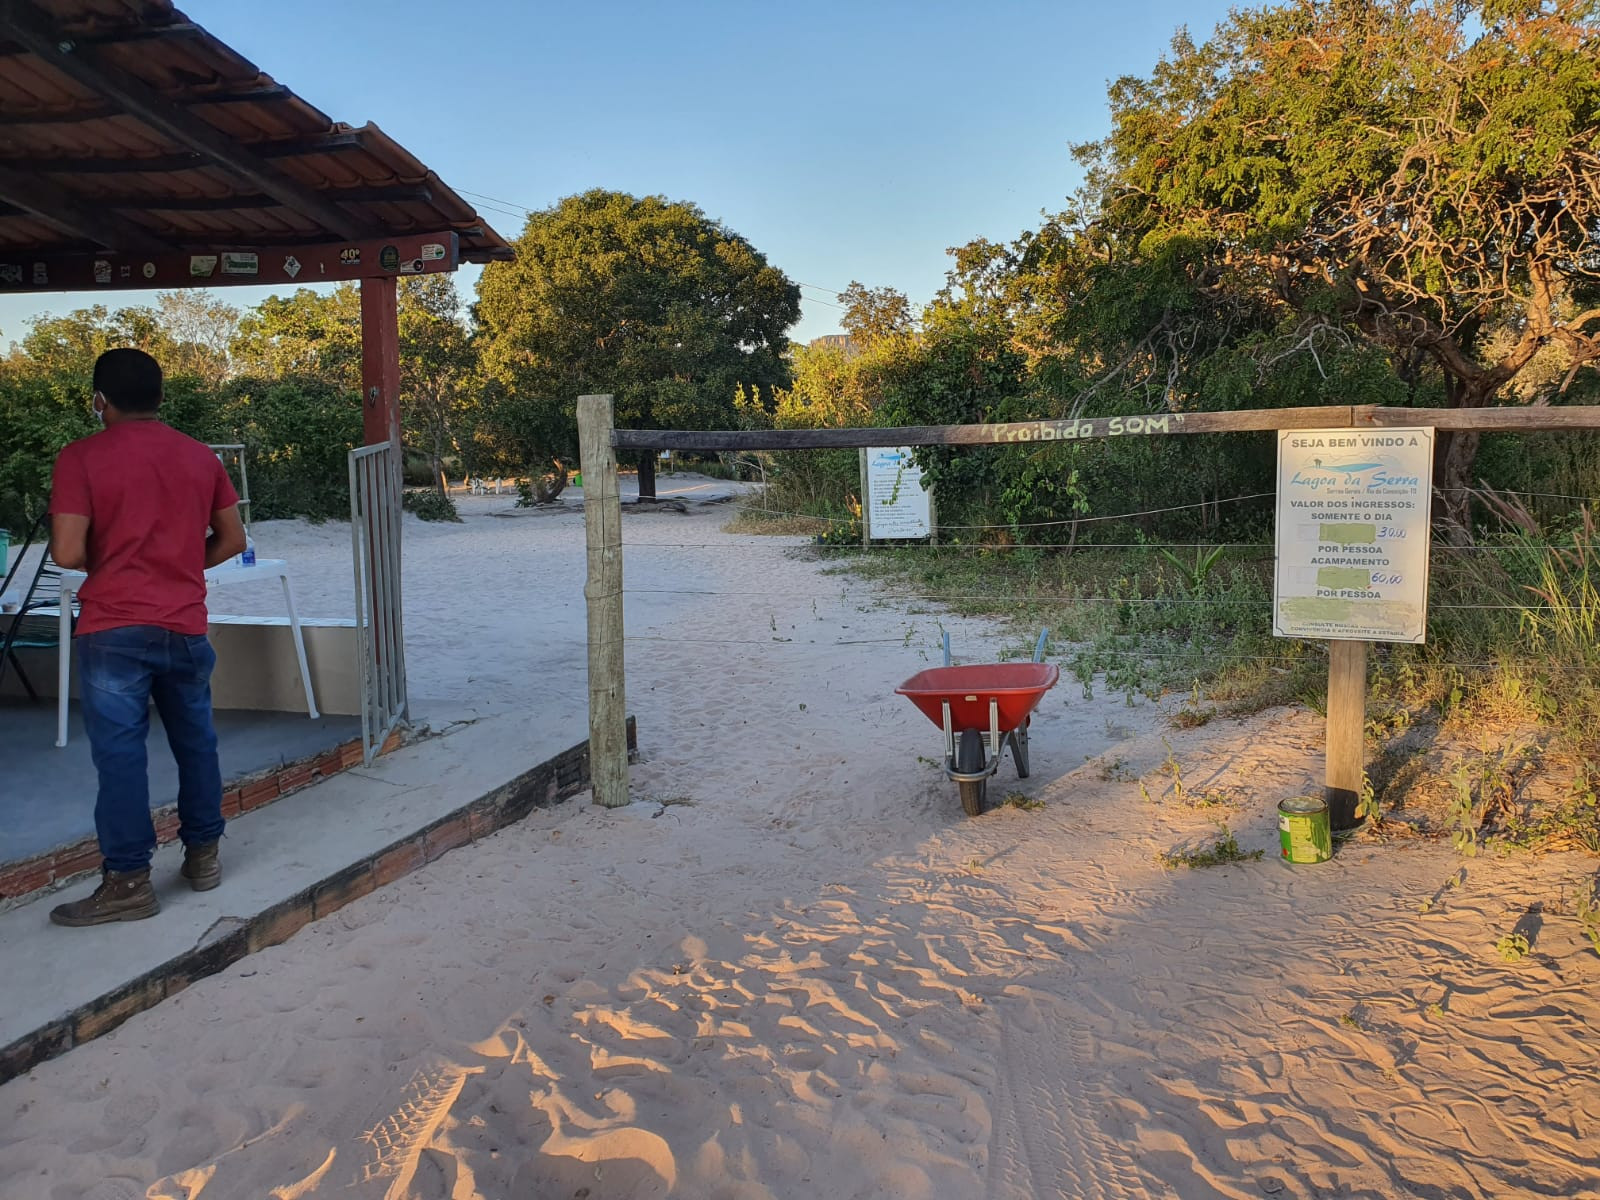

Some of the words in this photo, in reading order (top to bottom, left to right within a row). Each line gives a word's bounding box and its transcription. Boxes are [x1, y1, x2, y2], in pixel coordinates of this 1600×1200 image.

[1291, 439, 1324, 448] SEJA
[1328, 438, 1357, 448] BEM
[1361, 437, 1404, 447] VINDO
[1290, 472, 1337, 490] Lagoa
[1344, 473, 1361, 486] da
[1367, 471, 1418, 489] Serra
[1290, 500, 1324, 508] VALOR
[1327, 500, 1348, 508] DOS
[1351, 501, 1416, 509] INGRESSOS:
[1363, 513, 1371, 521] O
[1374, 513, 1393, 521] DIA
[1342, 546, 1383, 554] PESSOA
[1310, 557, 1390, 566] ACAMPAMENTO
[1316, 589, 1338, 597] POR
[1340, 590, 1382, 599] PESSOA
